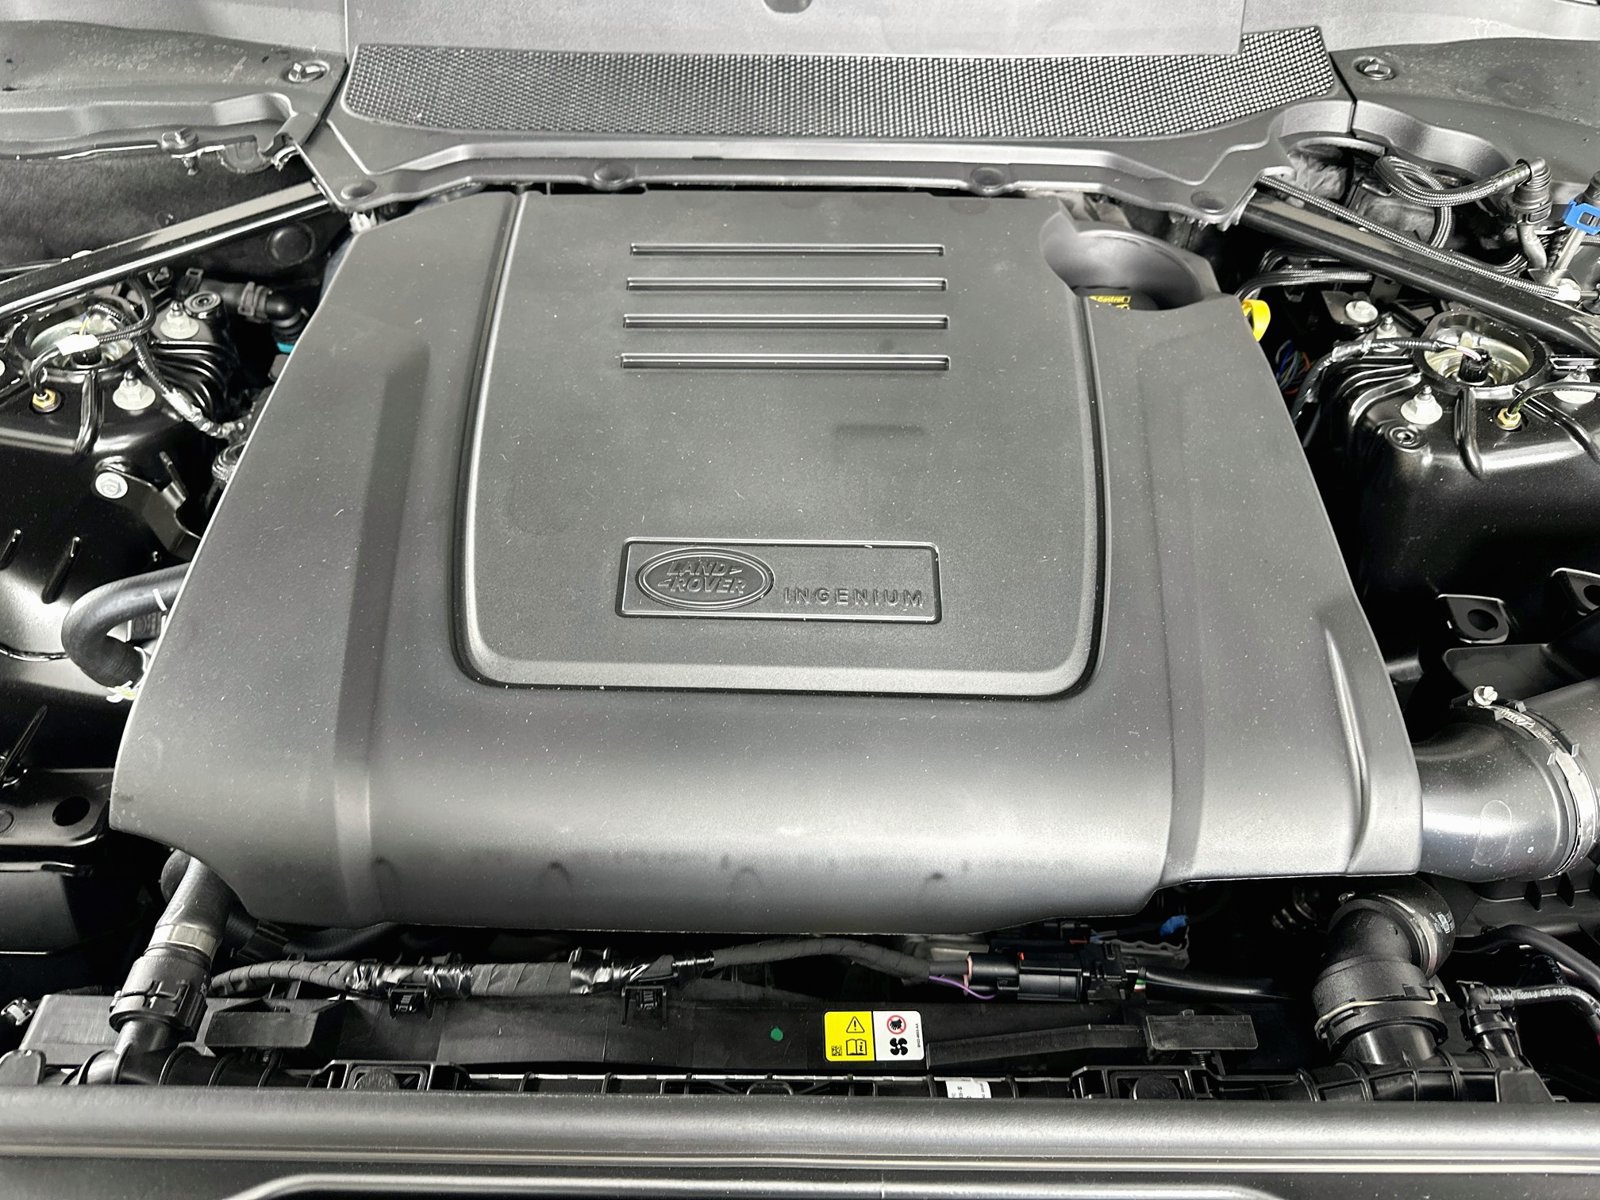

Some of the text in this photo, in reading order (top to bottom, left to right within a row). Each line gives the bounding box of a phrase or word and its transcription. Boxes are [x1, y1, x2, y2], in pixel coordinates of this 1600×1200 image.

[666, 561, 727, 577] LAND
[670, 576, 746, 594] ROVER
[783, 586, 923, 607] INGENIUM
